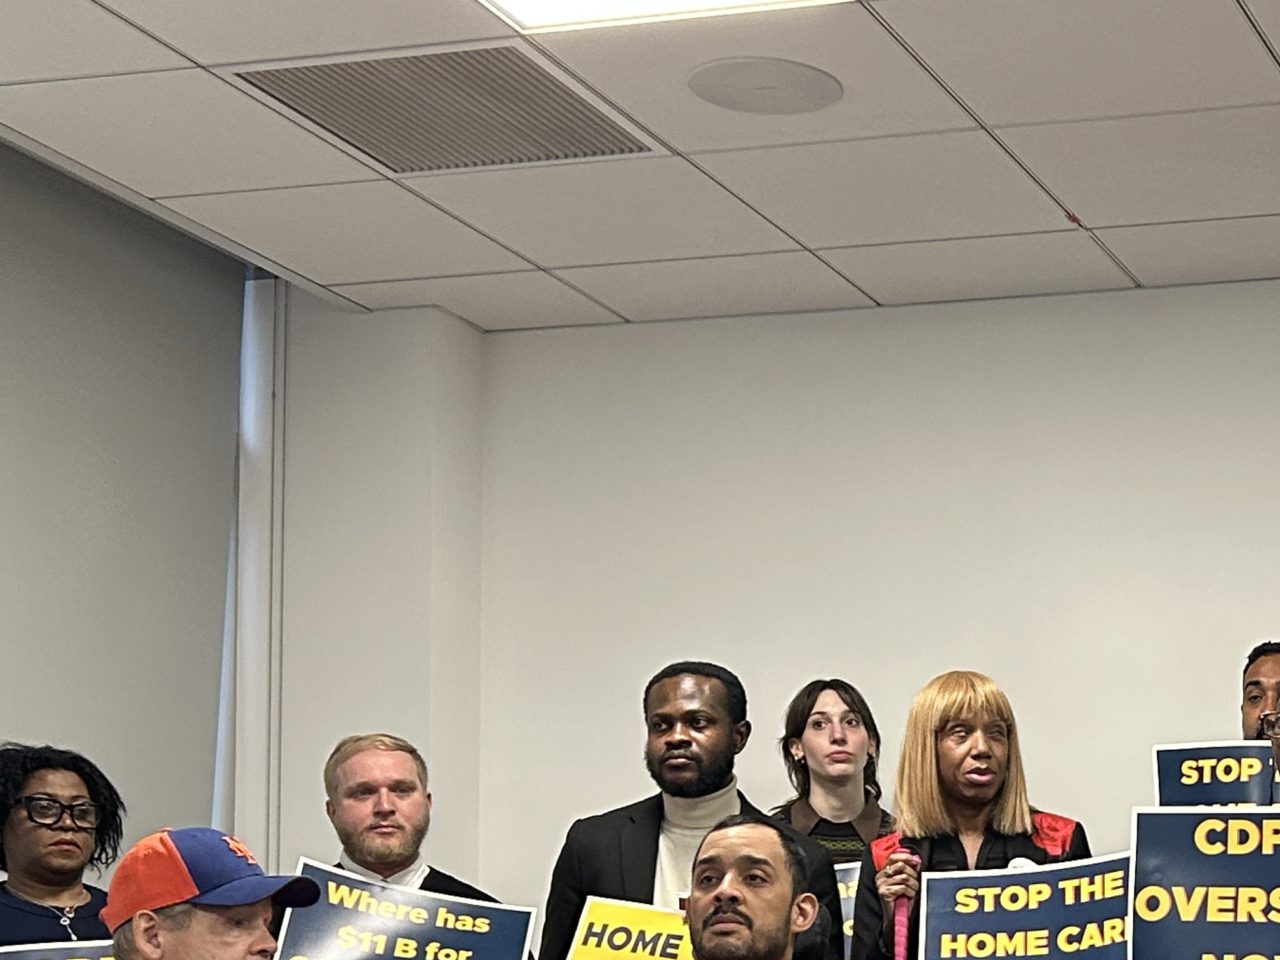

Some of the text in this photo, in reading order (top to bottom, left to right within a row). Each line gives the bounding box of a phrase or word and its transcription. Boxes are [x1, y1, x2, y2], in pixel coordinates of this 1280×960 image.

[1180, 757, 1263, 785] STOP
[327, 881, 491, 933] Where has
[955, 870, 1125, 914] STOP THE
[335, 924, 388, 956] $11
[393, 937, 417, 959] B
[581, 921, 684, 960] HOME
[941, 930, 1049, 959] HOME
